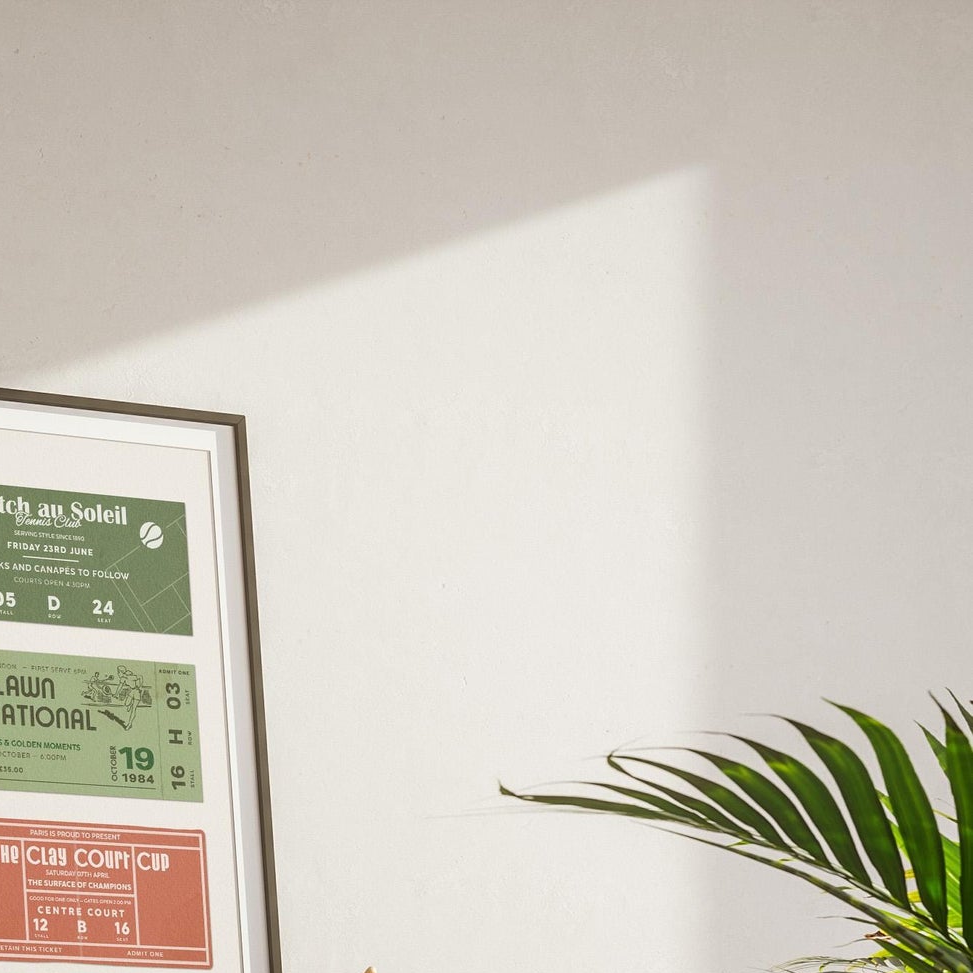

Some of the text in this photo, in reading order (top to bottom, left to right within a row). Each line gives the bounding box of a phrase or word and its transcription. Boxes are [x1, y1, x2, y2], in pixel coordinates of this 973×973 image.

[15, 511, 83, 529] Tennis Club
[37, 502, 63, 519] au
[71, 501, 128, 526] Soleil
[7, 541, 94, 556] FRIDAY 23RD JUNE
[12, 563, 32, 572] AND
[78, 569, 90, 577] TO
[92, 570, 130, 580] FOLLOW
[47, 595, 61, 611] D
[92, 599, 115, 616] 24
[165, 682, 182, 710] 03
[4, 739, 10, 747] &
[11, 740, 42, 749] GOLDEN
[43, 742, 81, 751] MOMENTS
[168, 728, 184, 745] H
[109, 745, 118, 782] OCTOBER
[118, 746, 155, 771] 19
[122, 773, 155, 784] 1984
[170, 765, 186, 791] 16
[30, 829, 49, 837] PARIS
[57, 830, 81, 839] PROUD
[92, 833, 121, 841] PRESENT
[46, 869, 75, 877] SATURDAY
[93, 871, 110, 879] APRIL
[28, 878, 132, 891] THE SURFACE OF CHAMPIONS
[37, 905, 125, 918] CENTRE COURT
[33, 918, 130, 935] 12 B 16
